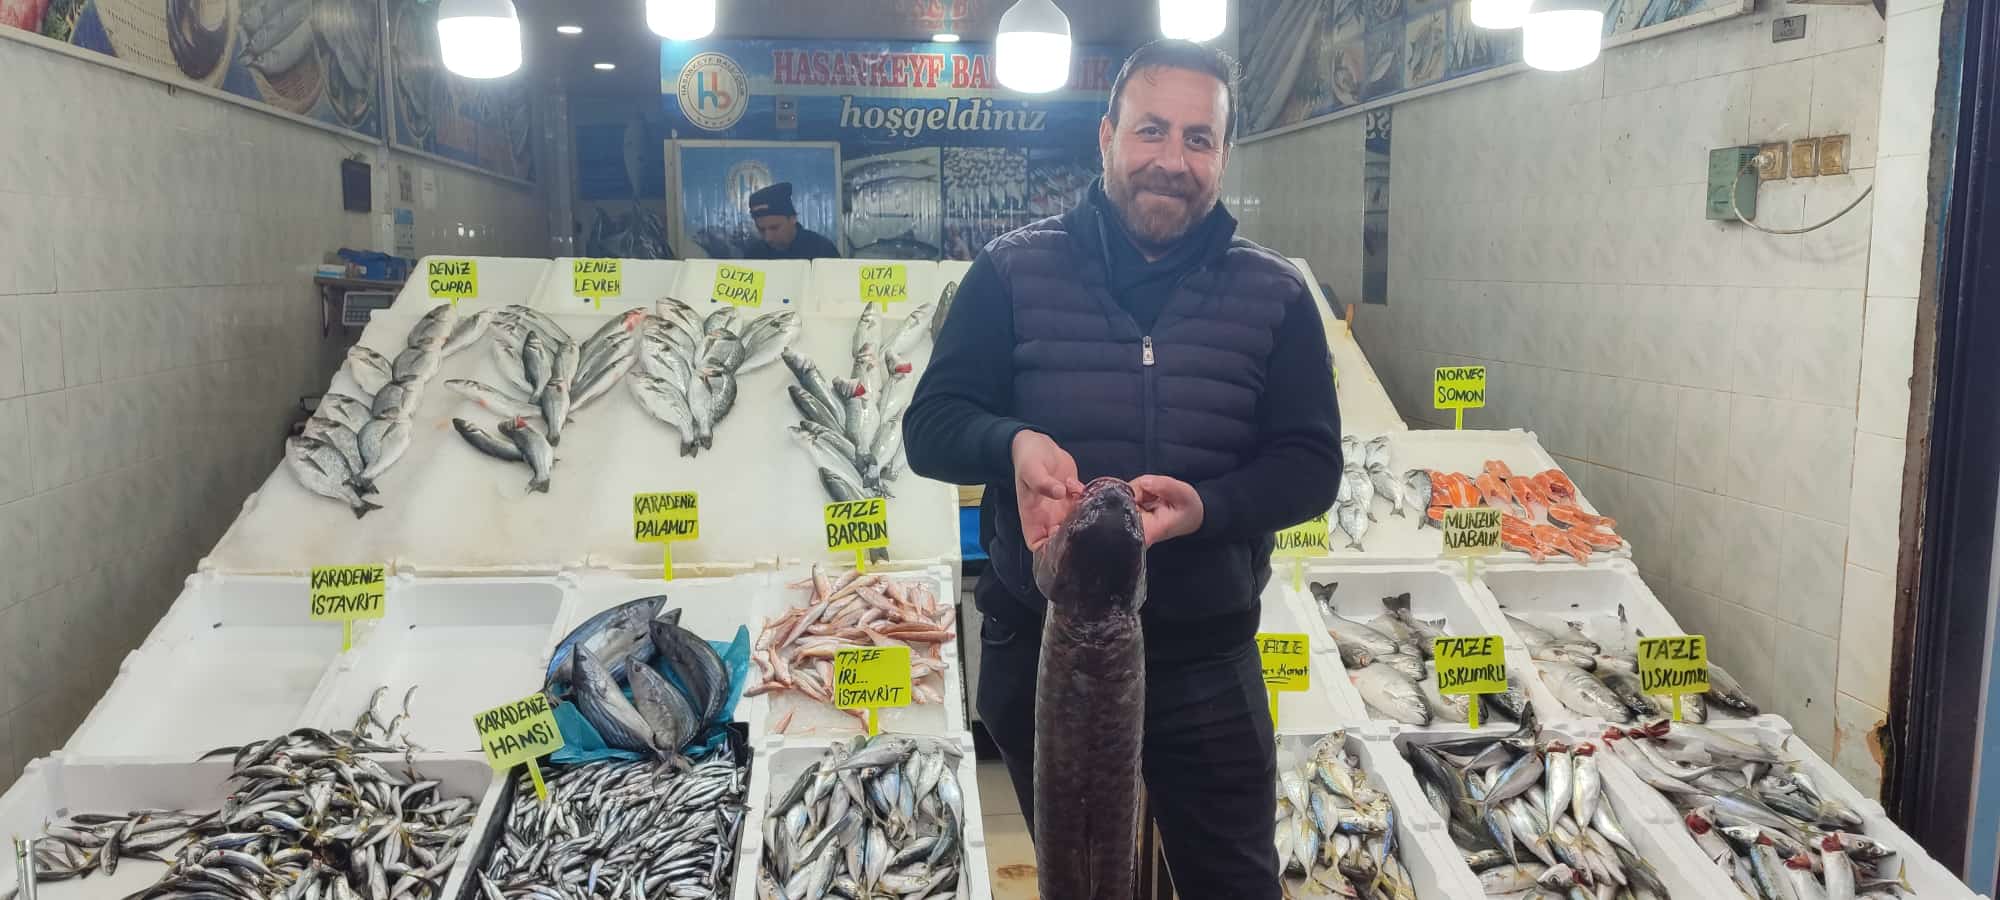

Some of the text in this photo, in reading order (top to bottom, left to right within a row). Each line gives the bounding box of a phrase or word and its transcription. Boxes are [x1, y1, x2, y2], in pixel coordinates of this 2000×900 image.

[773, 52, 945, 88] HASANKEYF
[839, 96, 1048, 138] hoşgeldiniz
[429, 261, 471, 276] DENİZ
[720, 268, 754, 284] OLTA
[861, 267, 893, 280] OLTA
[430, 279, 473, 294] ÇUPRA
[716, 282, 758, 304] ÇUPRA
[1436, 367, 1485, 382] NORVEÇ
[1438, 385, 1484, 404] SOMON
[634, 493, 697, 515] KARADENİZ
[826, 499, 881, 520] TAZE
[635, 519, 698, 540] PALAMUT
[826, 519, 888, 548] BARBUN
[311, 567, 385, 590] KARADENİZ
[837, 648, 889, 665] TAZE
[1435, 636, 1494, 658] TAZE
[1639, 637, 1702, 660] TAZE
[838, 684, 905, 707] İSTAVRİT
[475, 695, 549, 737] KARADENİZ
[489, 720, 555, 760] HAMSİ
